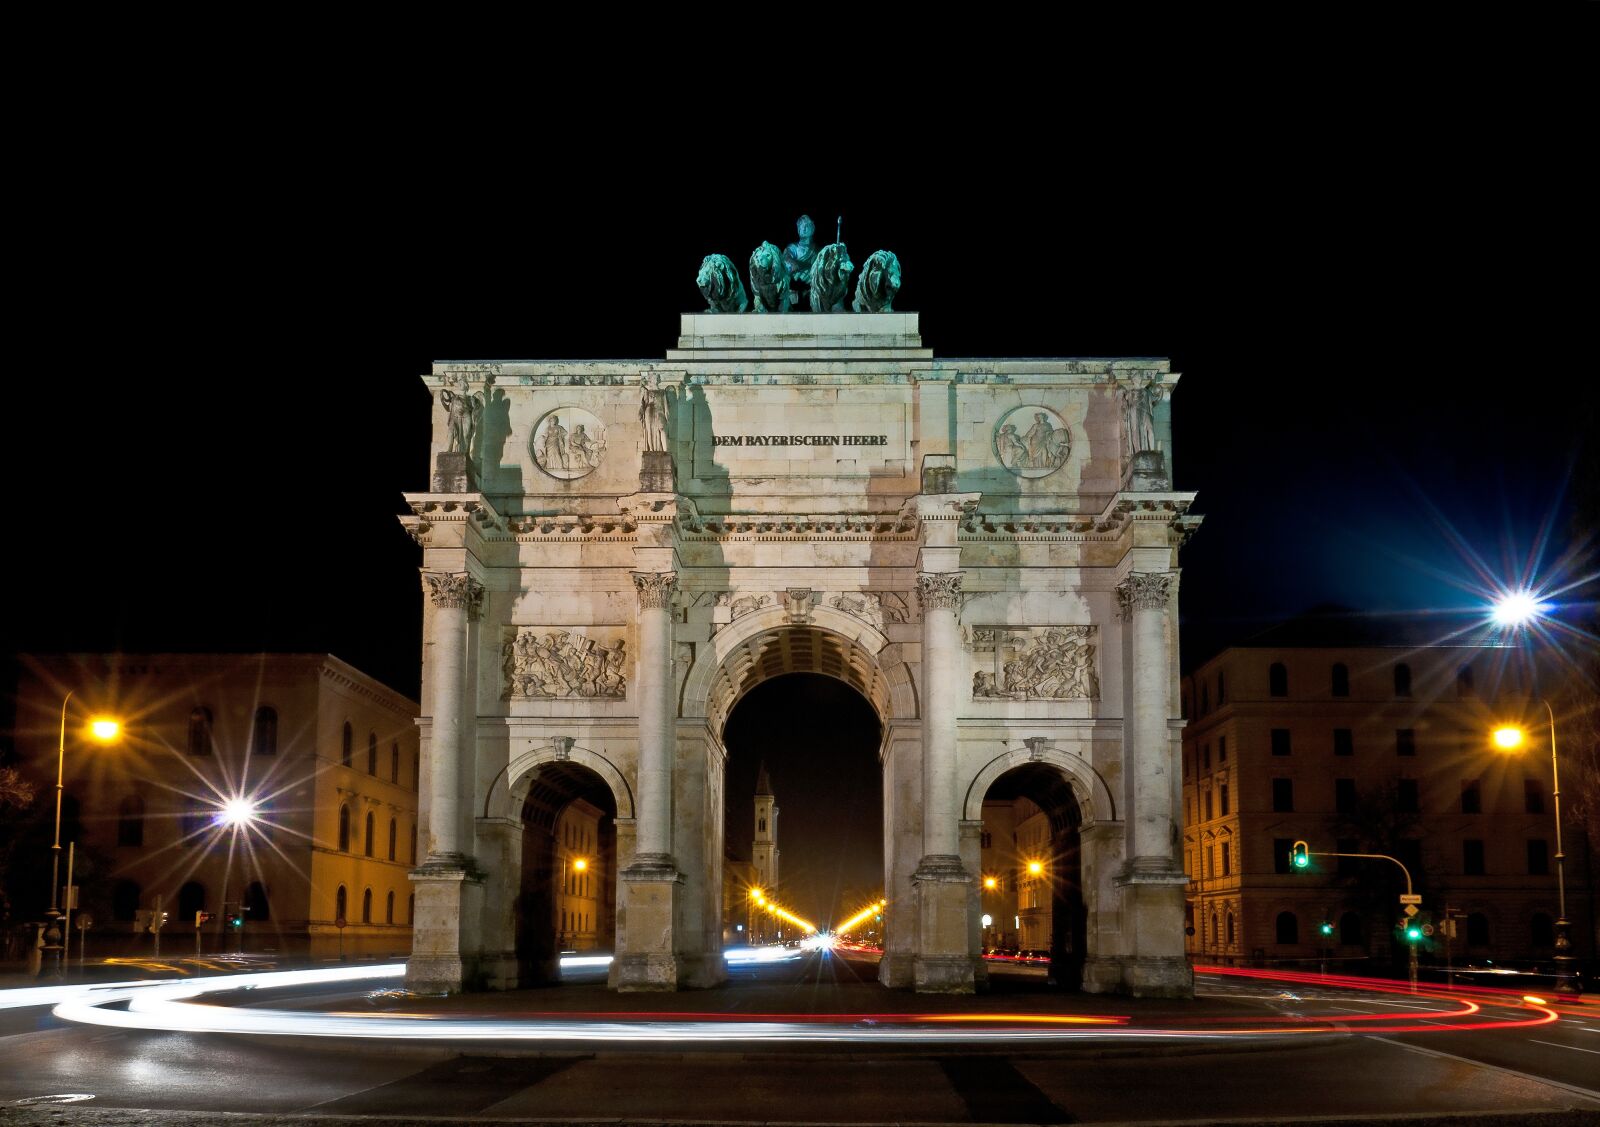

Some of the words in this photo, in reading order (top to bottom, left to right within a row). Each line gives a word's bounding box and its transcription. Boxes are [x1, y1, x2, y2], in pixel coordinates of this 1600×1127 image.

[711, 435, 743, 446] DEM
[745, 435, 840, 446] BAYERISCHEN
[842, 435, 888, 446] HEERE
